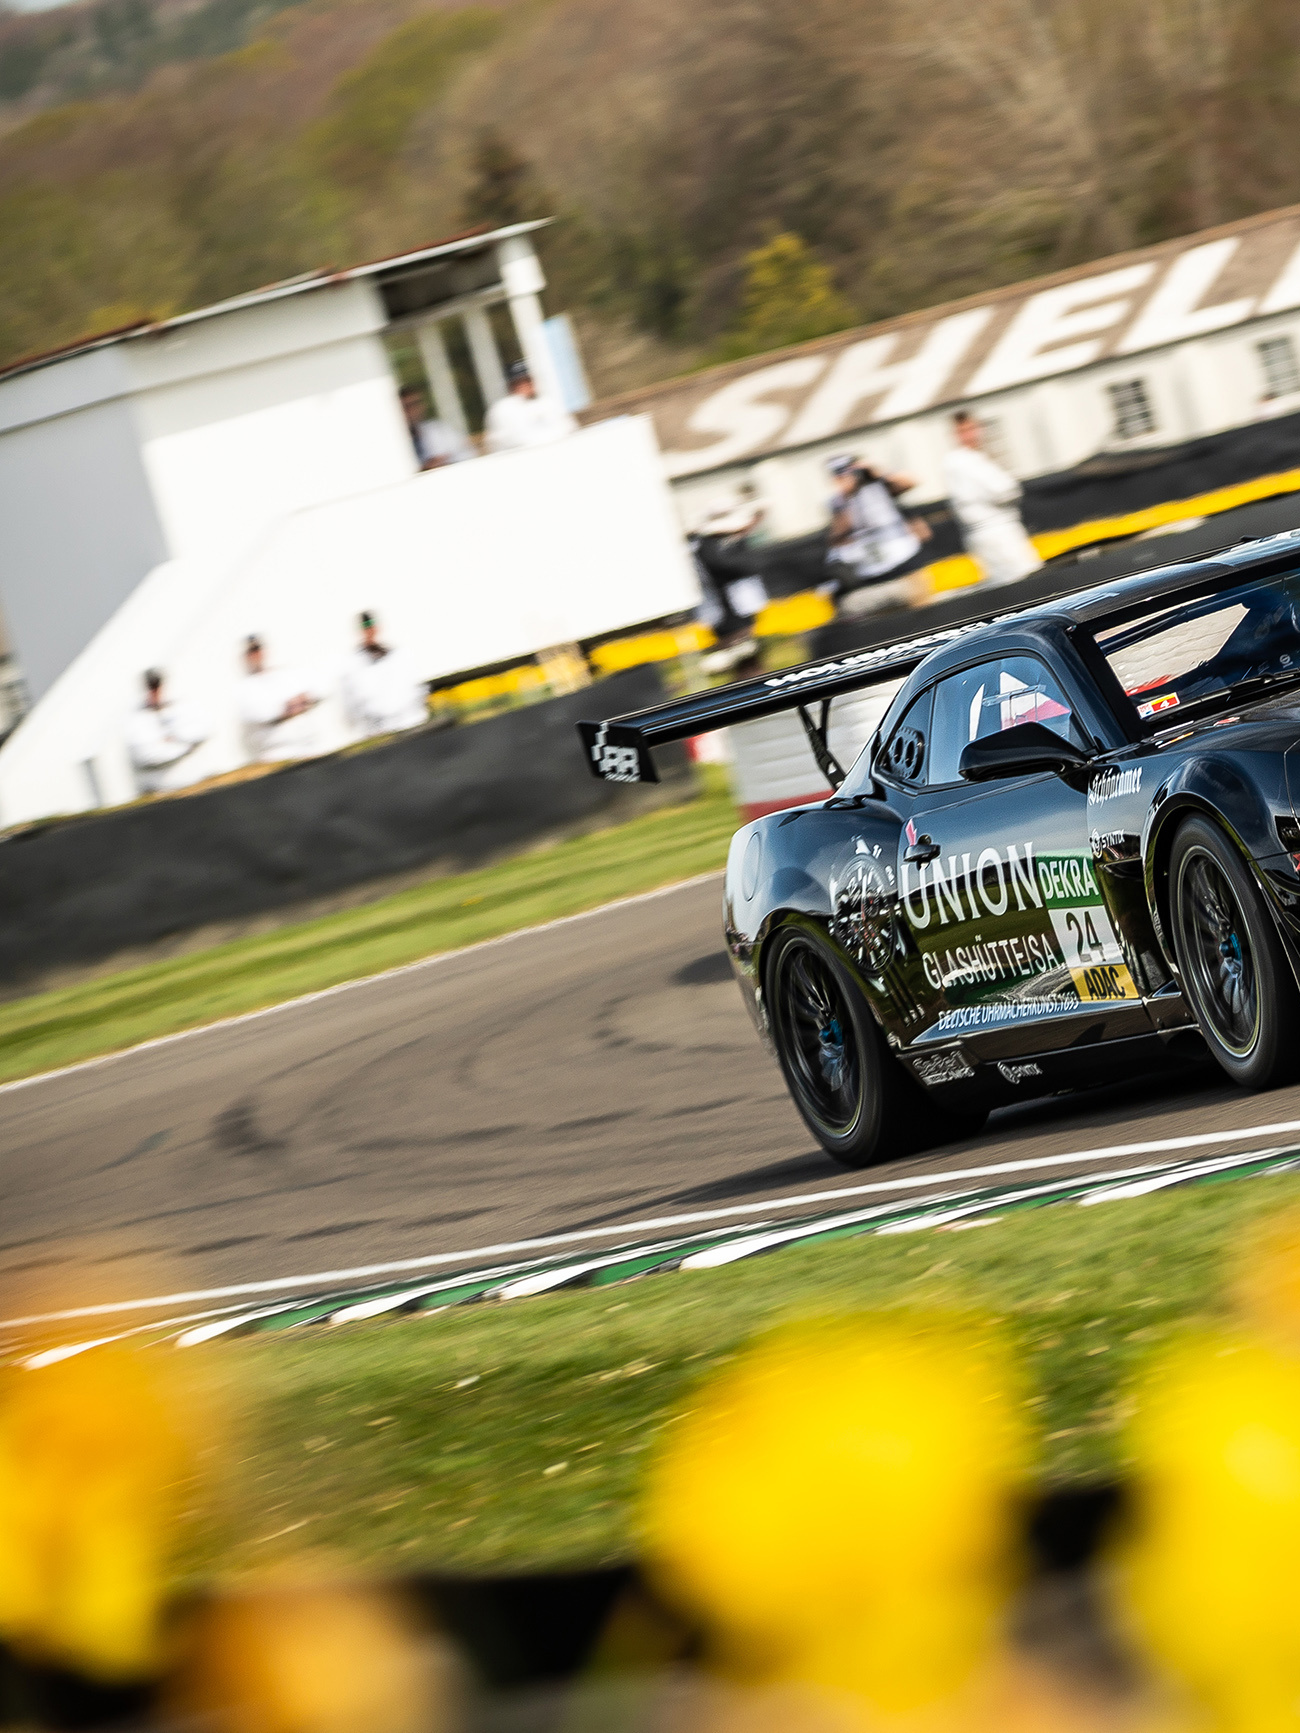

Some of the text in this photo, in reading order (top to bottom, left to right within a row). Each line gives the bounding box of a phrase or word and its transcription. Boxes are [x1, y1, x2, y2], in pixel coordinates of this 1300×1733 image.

[900, 841, 1044, 929] UNION
[1038, 857, 1099, 899] DEKRA
[922, 932, 1061, 990] GLASHÜTTE/SA
[1065, 911, 1107, 962] 24
[1083, 965, 1127, 1000] ADAC
